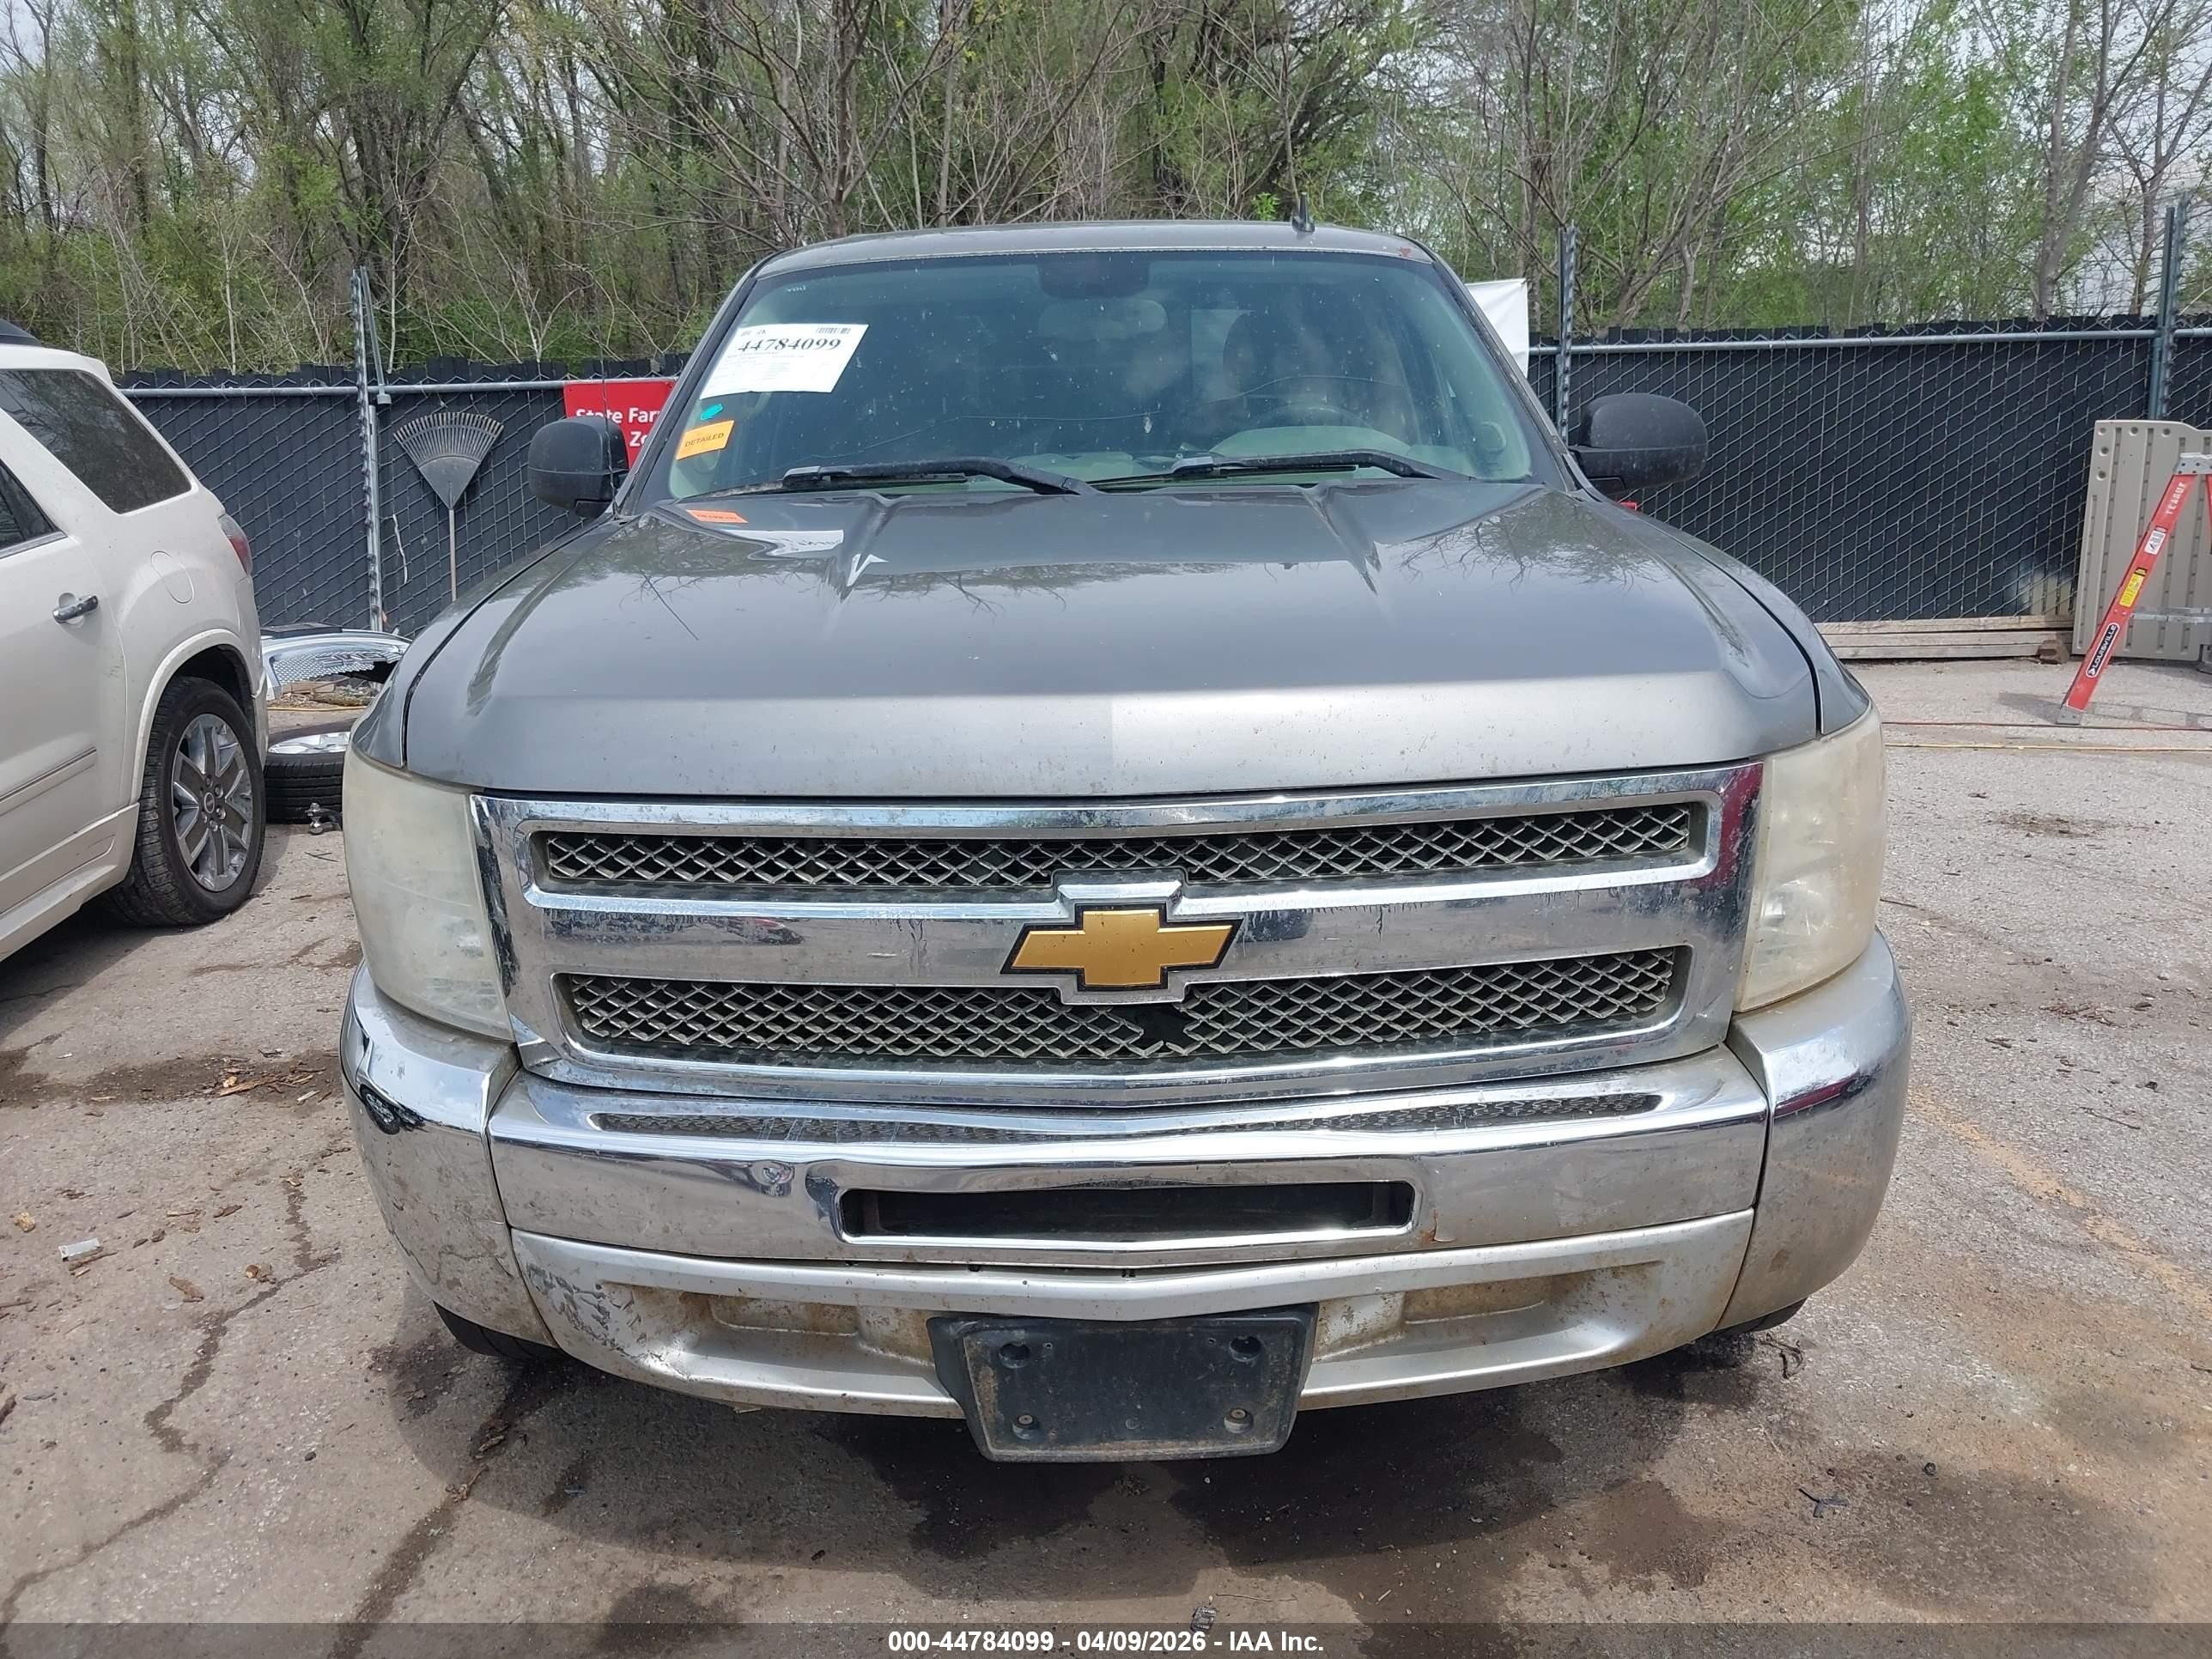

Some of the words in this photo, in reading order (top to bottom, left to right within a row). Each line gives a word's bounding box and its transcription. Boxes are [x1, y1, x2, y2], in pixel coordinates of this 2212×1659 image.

[738, 337, 842, 352] 44784099
[628, 407, 660, 423] Far
[684, 432, 725, 447] DETAILED
[2092, 624, 2118, 670] LOUISVILLE
